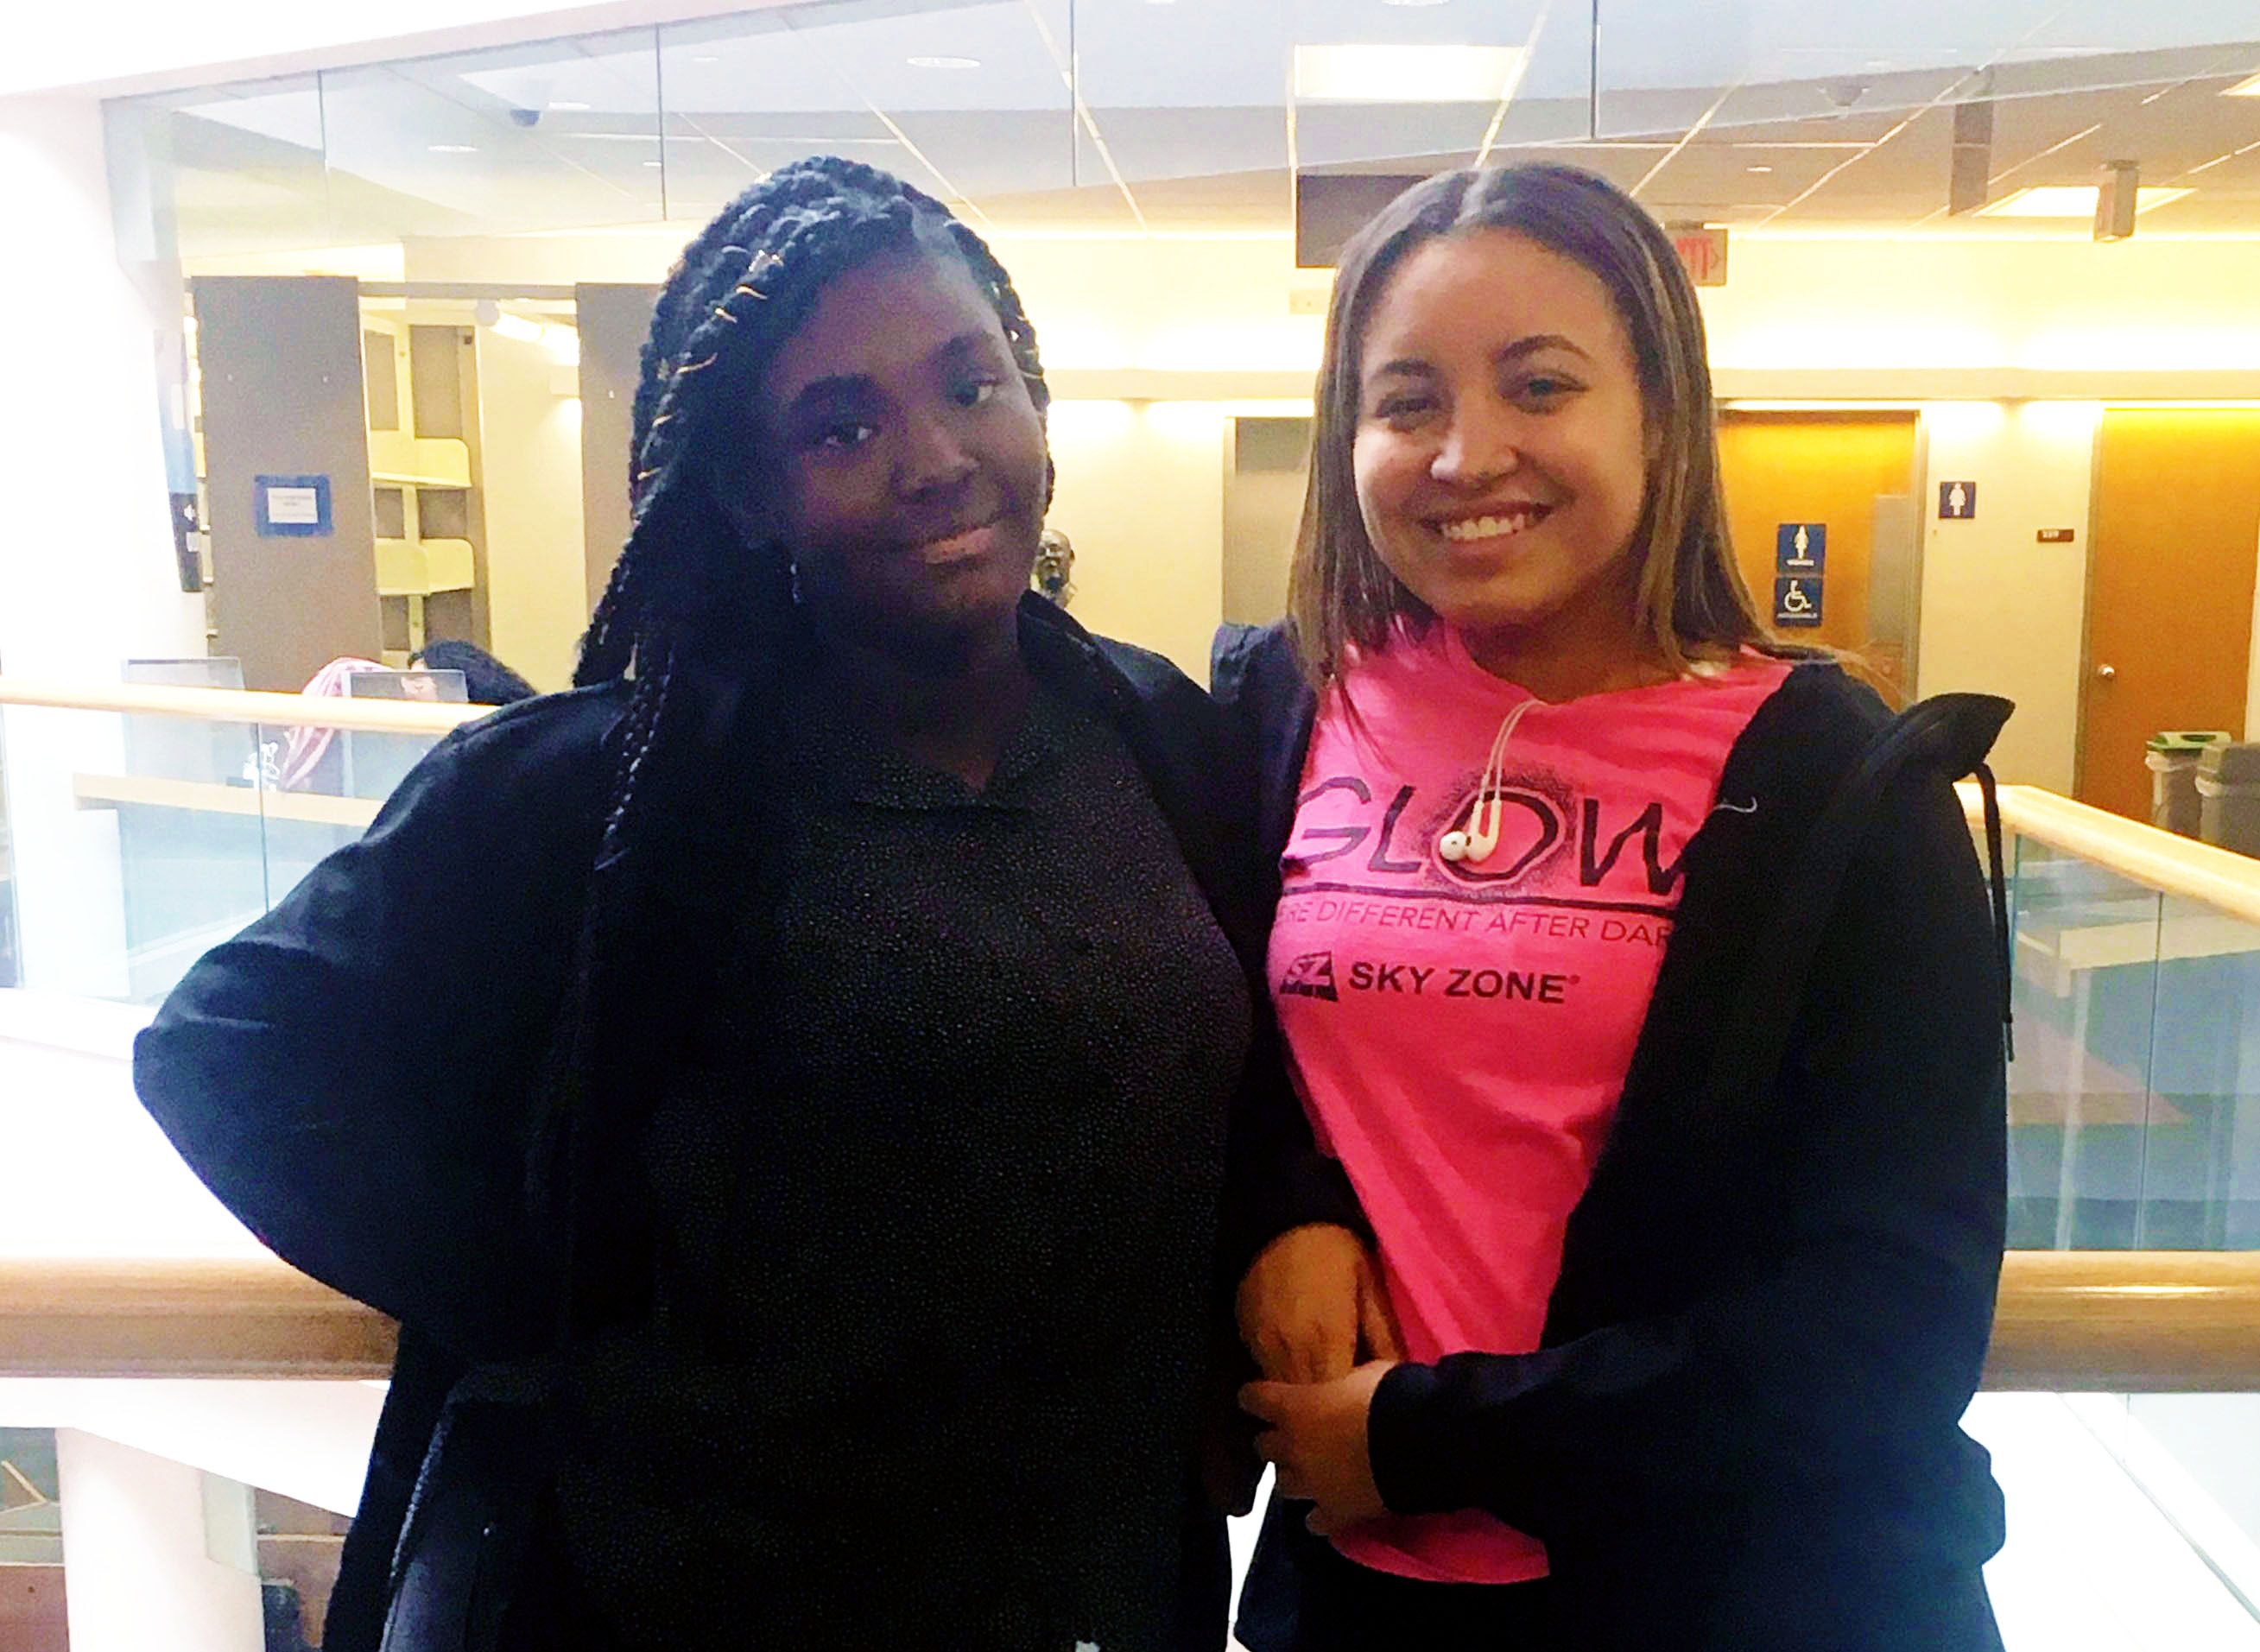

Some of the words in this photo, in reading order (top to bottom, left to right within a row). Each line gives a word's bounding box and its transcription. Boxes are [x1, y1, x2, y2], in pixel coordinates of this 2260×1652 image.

[1281, 775, 1689, 896] GLOW
[1316, 900, 1480, 932] DIFFERENT
[1485, 911, 1590, 940] AFTER
[1600, 919, 1673, 947] DAR
[1348, 961, 1435, 995] SKY
[1445, 967, 1567, 1004] ZONE
